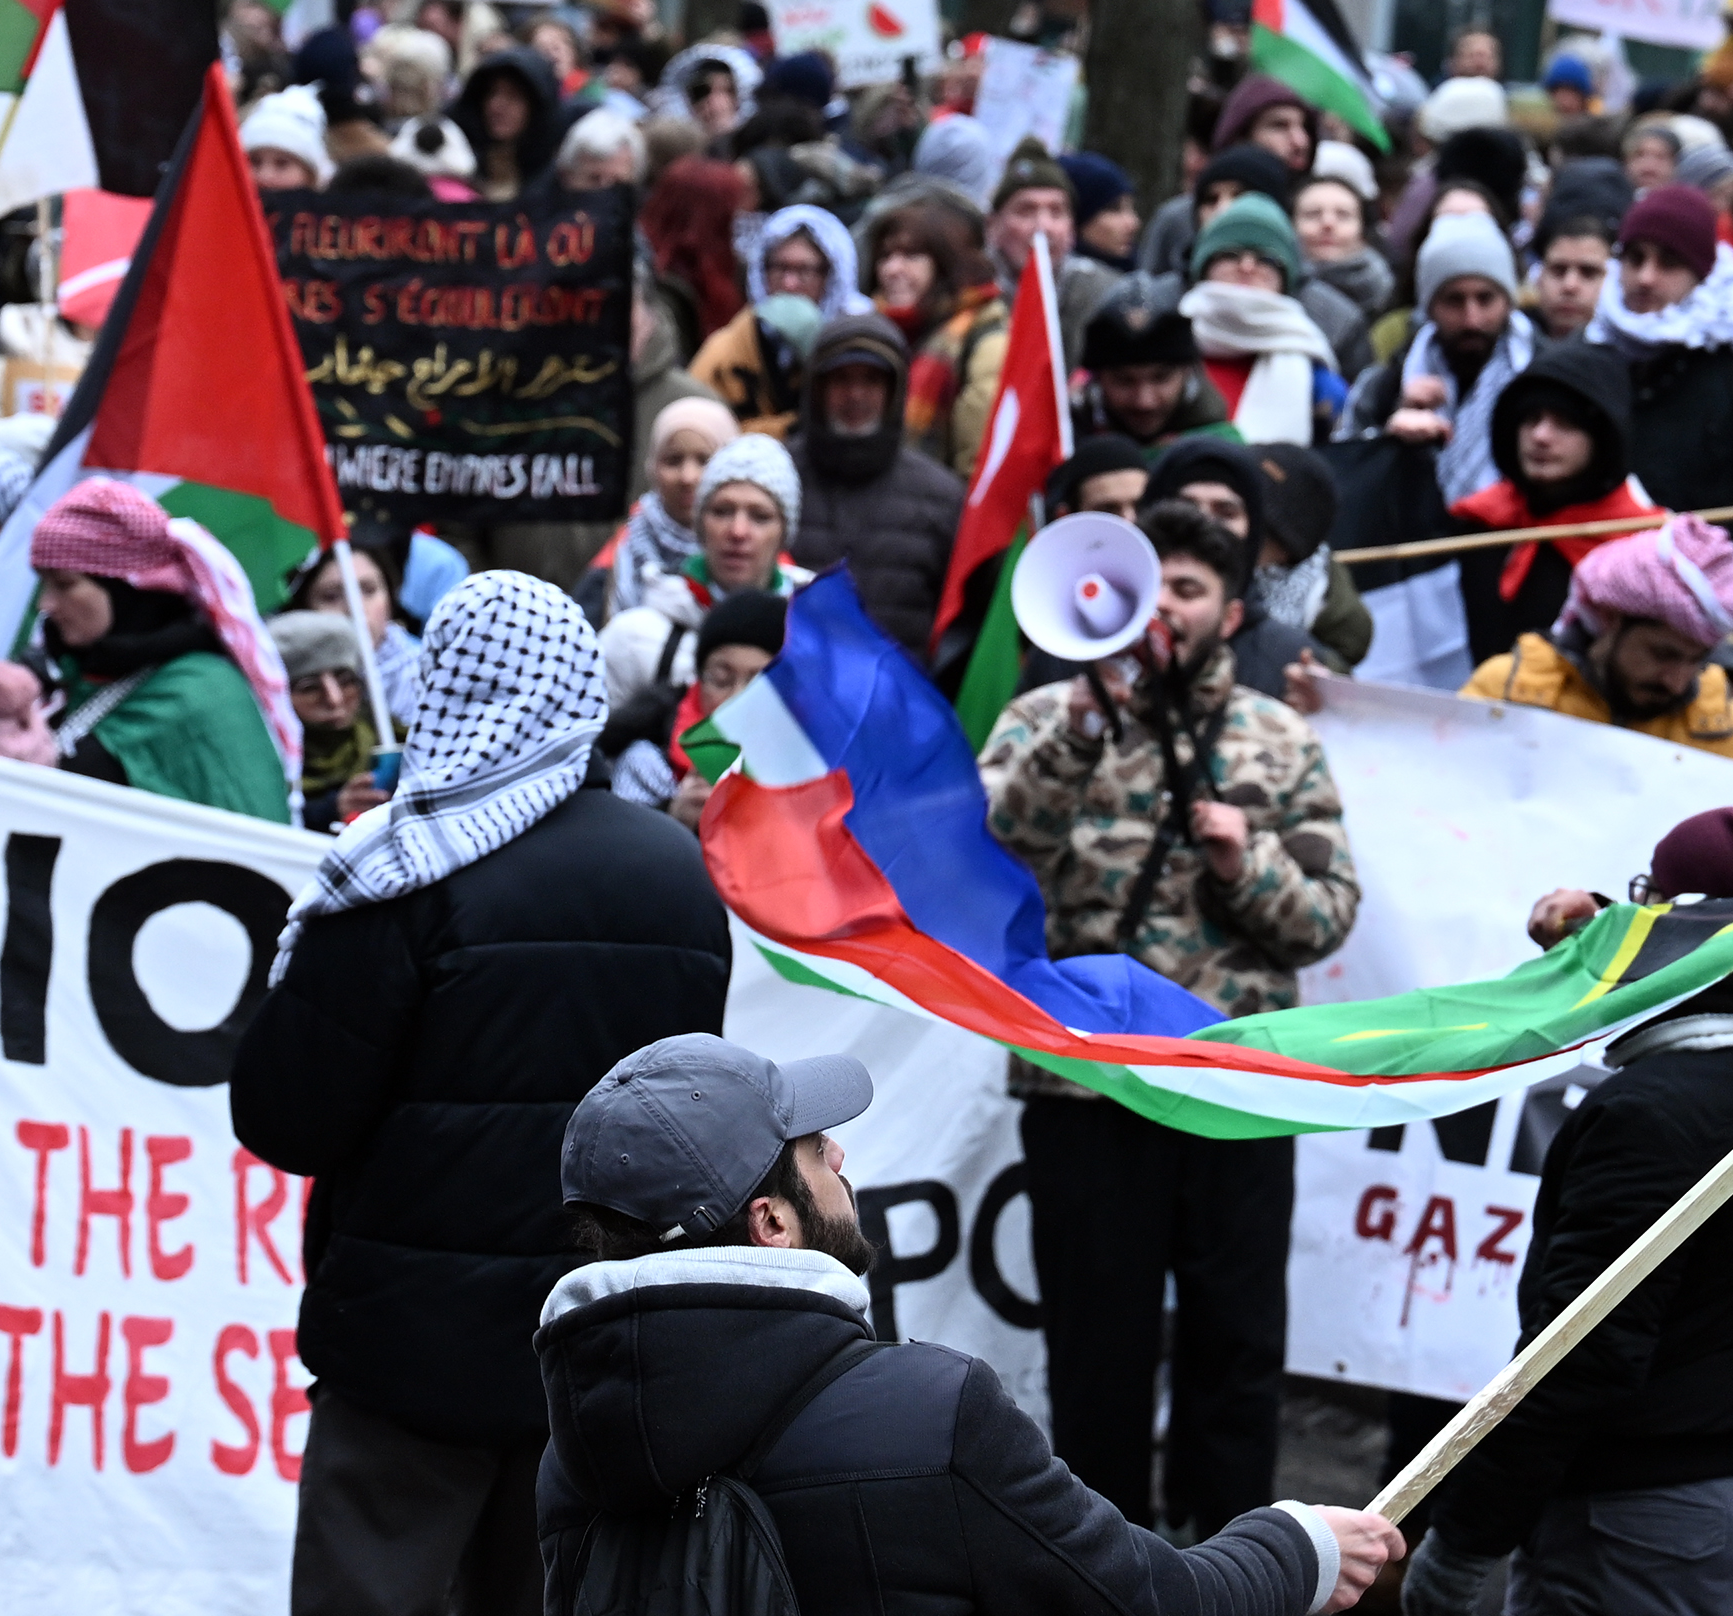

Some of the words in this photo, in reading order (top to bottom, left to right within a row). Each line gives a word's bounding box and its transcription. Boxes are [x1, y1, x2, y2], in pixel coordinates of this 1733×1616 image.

[495, 212, 538, 269] LÀ
[547, 209, 595, 267] OÙ
[336, 443, 423, 494] WHERE
[424, 451, 528, 499] EMPIRES
[531, 453, 602, 499] FALL
[16, 1118, 193, 1281] THE
[210, 1323, 306, 1482] SE
